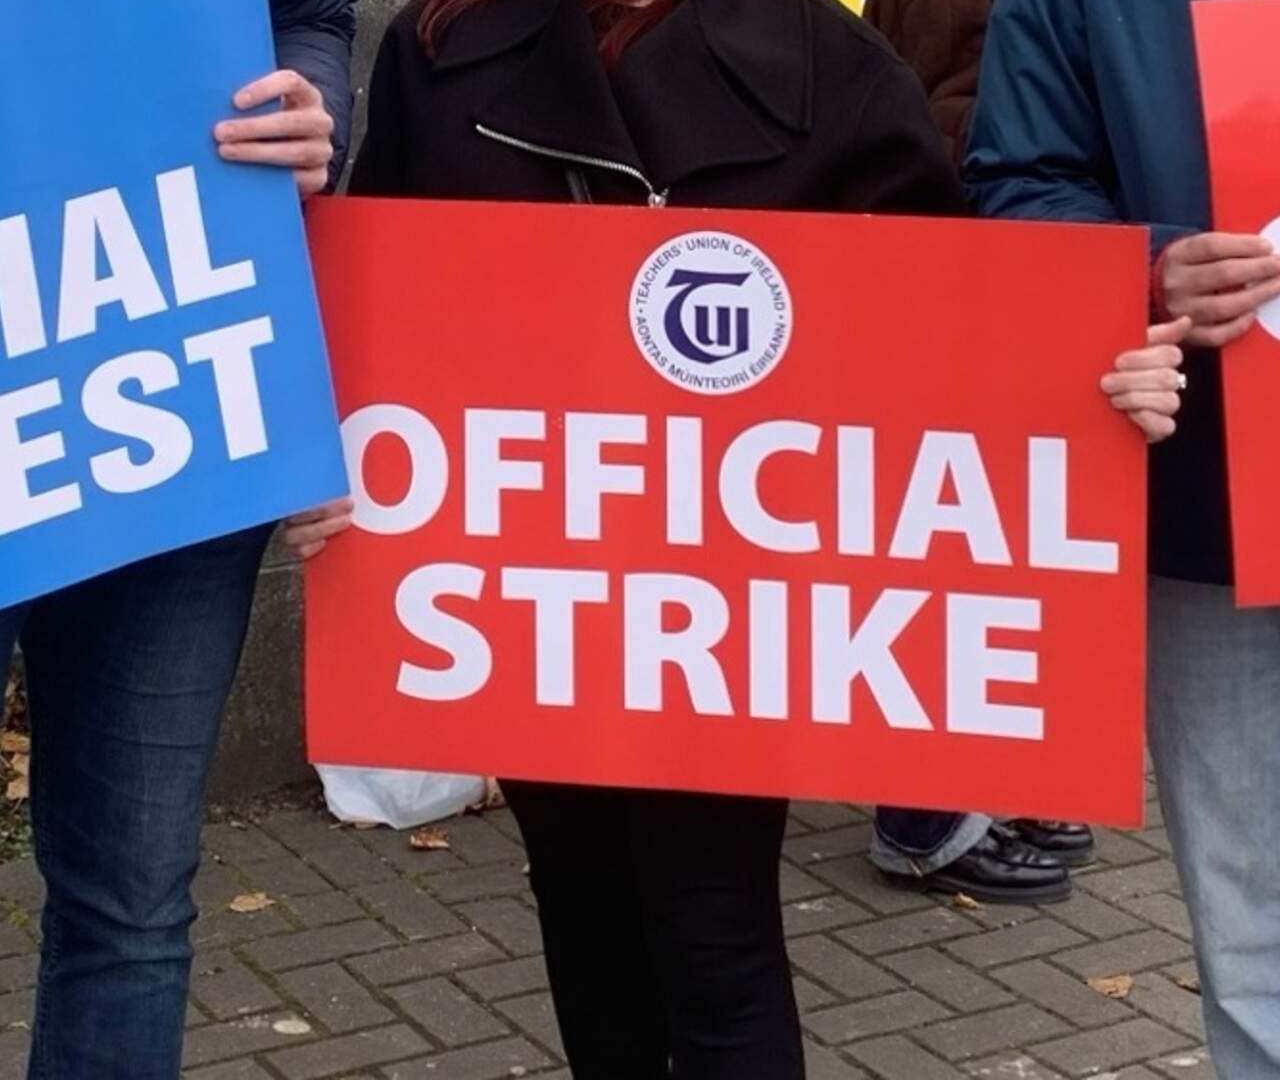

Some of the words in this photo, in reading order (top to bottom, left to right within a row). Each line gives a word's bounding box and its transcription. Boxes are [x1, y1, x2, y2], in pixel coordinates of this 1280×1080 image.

[685, 236, 731, 252] UNION
[733, 243, 753, 259] OF
[750, 255, 786, 311] IRELAND
[635, 315, 669, 367] AONTAS
[339, 403, 1119, 574] OFFICIAL
[395, 562, 1045, 741] STRIKE
